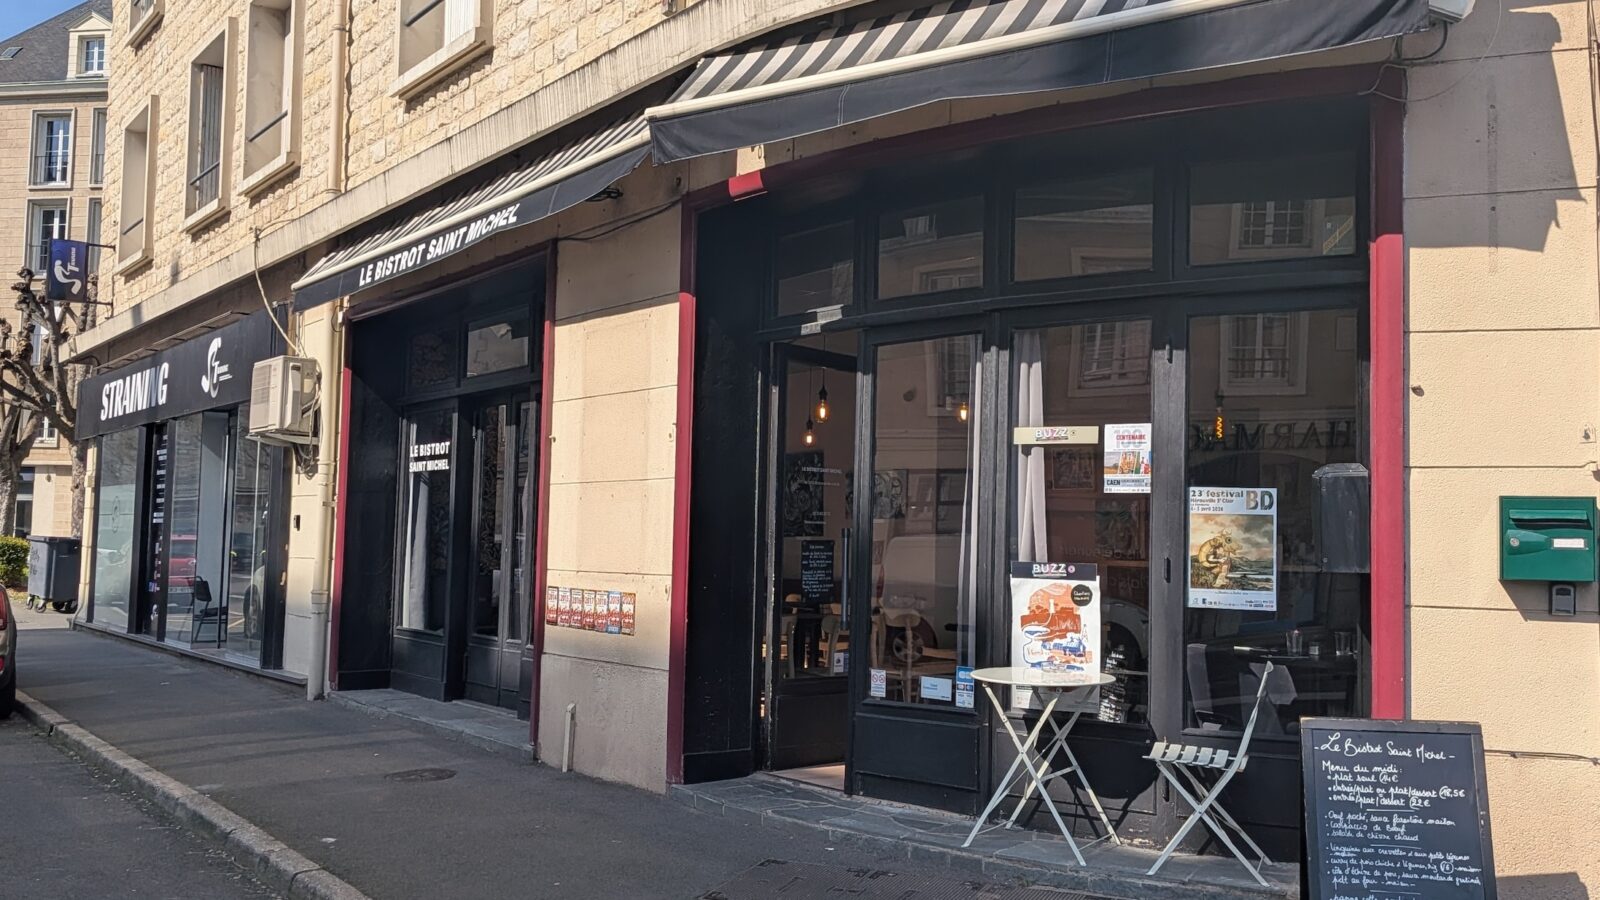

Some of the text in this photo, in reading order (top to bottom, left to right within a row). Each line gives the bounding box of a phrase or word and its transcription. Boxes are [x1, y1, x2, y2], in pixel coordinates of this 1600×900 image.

[359, 203, 520, 287] LE BISTROT SAINT MICHEL
[100, 362, 170, 421] STRAINING
[1035, 428, 1068, 438] BUZZ
[410, 441, 450, 457] LE BISTROT
[409, 459, 449, 472] SAINT MICHEL
[1206, 490, 1244, 498] festival
[1246, 490, 1274, 510] BD
[1032, 564, 1067, 573] BUZZ
[1320, 732, 1447, 763] Le Bistrot Saint Michel
[1322, 760, 1350, 774] Menu
[1353, 764, 1369, 773] du
[1332, 773, 1354, 786] plat
[1394, 833, 1419, 841] chaud
